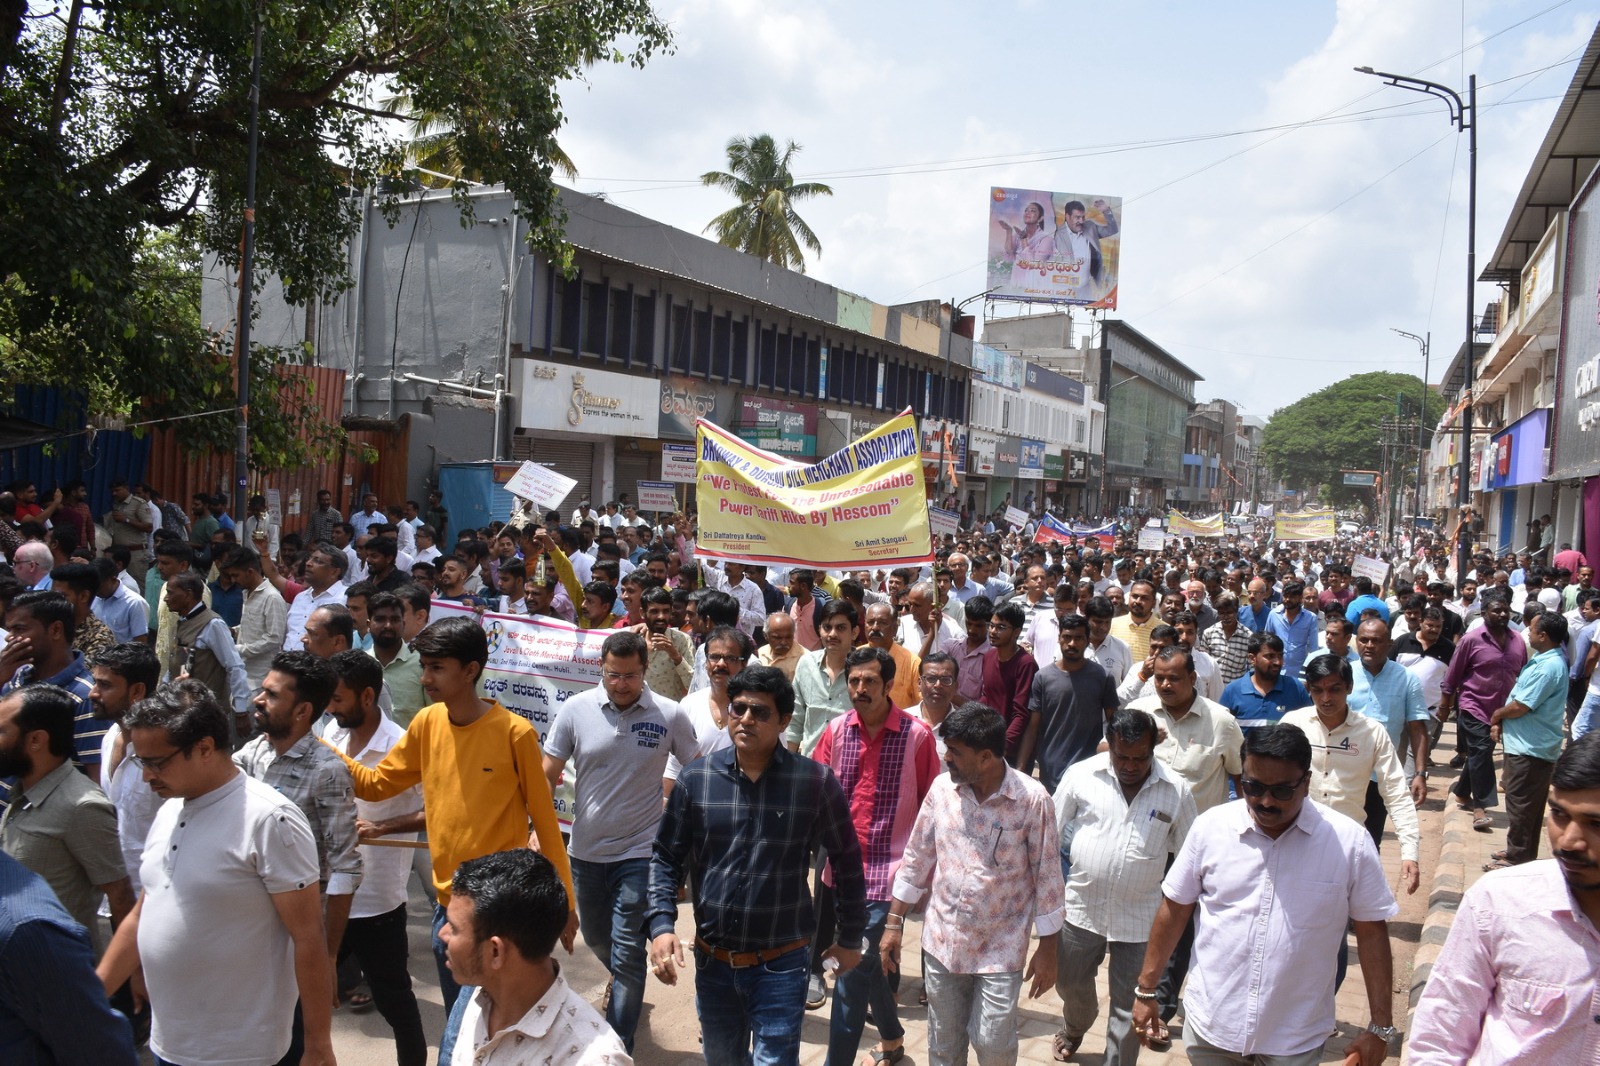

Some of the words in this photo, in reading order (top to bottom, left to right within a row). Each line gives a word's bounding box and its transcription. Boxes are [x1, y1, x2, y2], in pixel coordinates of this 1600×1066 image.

[582, 406, 600, 417] Express
[601, 410, 609, 418] the
[610, 412, 626, 420] woman
[739, 461, 751, 473] &
[803, 448, 855, 484] MERCHANT
[853, 427, 918, 471] ASSOCIATION
[733, 479, 762, 499] Ptest
[819, 472, 915, 503] Unreasonable
[719, 498, 753, 516] Power
[754, 505, 779, 522] Tariff
[781, 509, 806, 525] Hike
[810, 511, 828, 527] By
[831, 498, 900, 522] Hescom”
[703, 531, 713, 539] Sri
[714, 532, 745, 541] Dattatreya
[854, 540, 865, 548] Sri
[866, 538, 881, 547] Amit
[882, 534, 908, 546] Sangavi
[723, 543, 751, 551] President
[868, 547, 899, 556] Secretary
[523, 647, 539, 657] Cloth
[539, 650, 570, 662] Merchant
[508, 658, 517, 666] Floor
[554, 665, 572, 674] Hubli.
[512, 682, 549, 706] ದರವನ್ನು
[630, 721, 668, 738] SUPERDRY
[638, 731, 660, 740] COLLEGE
